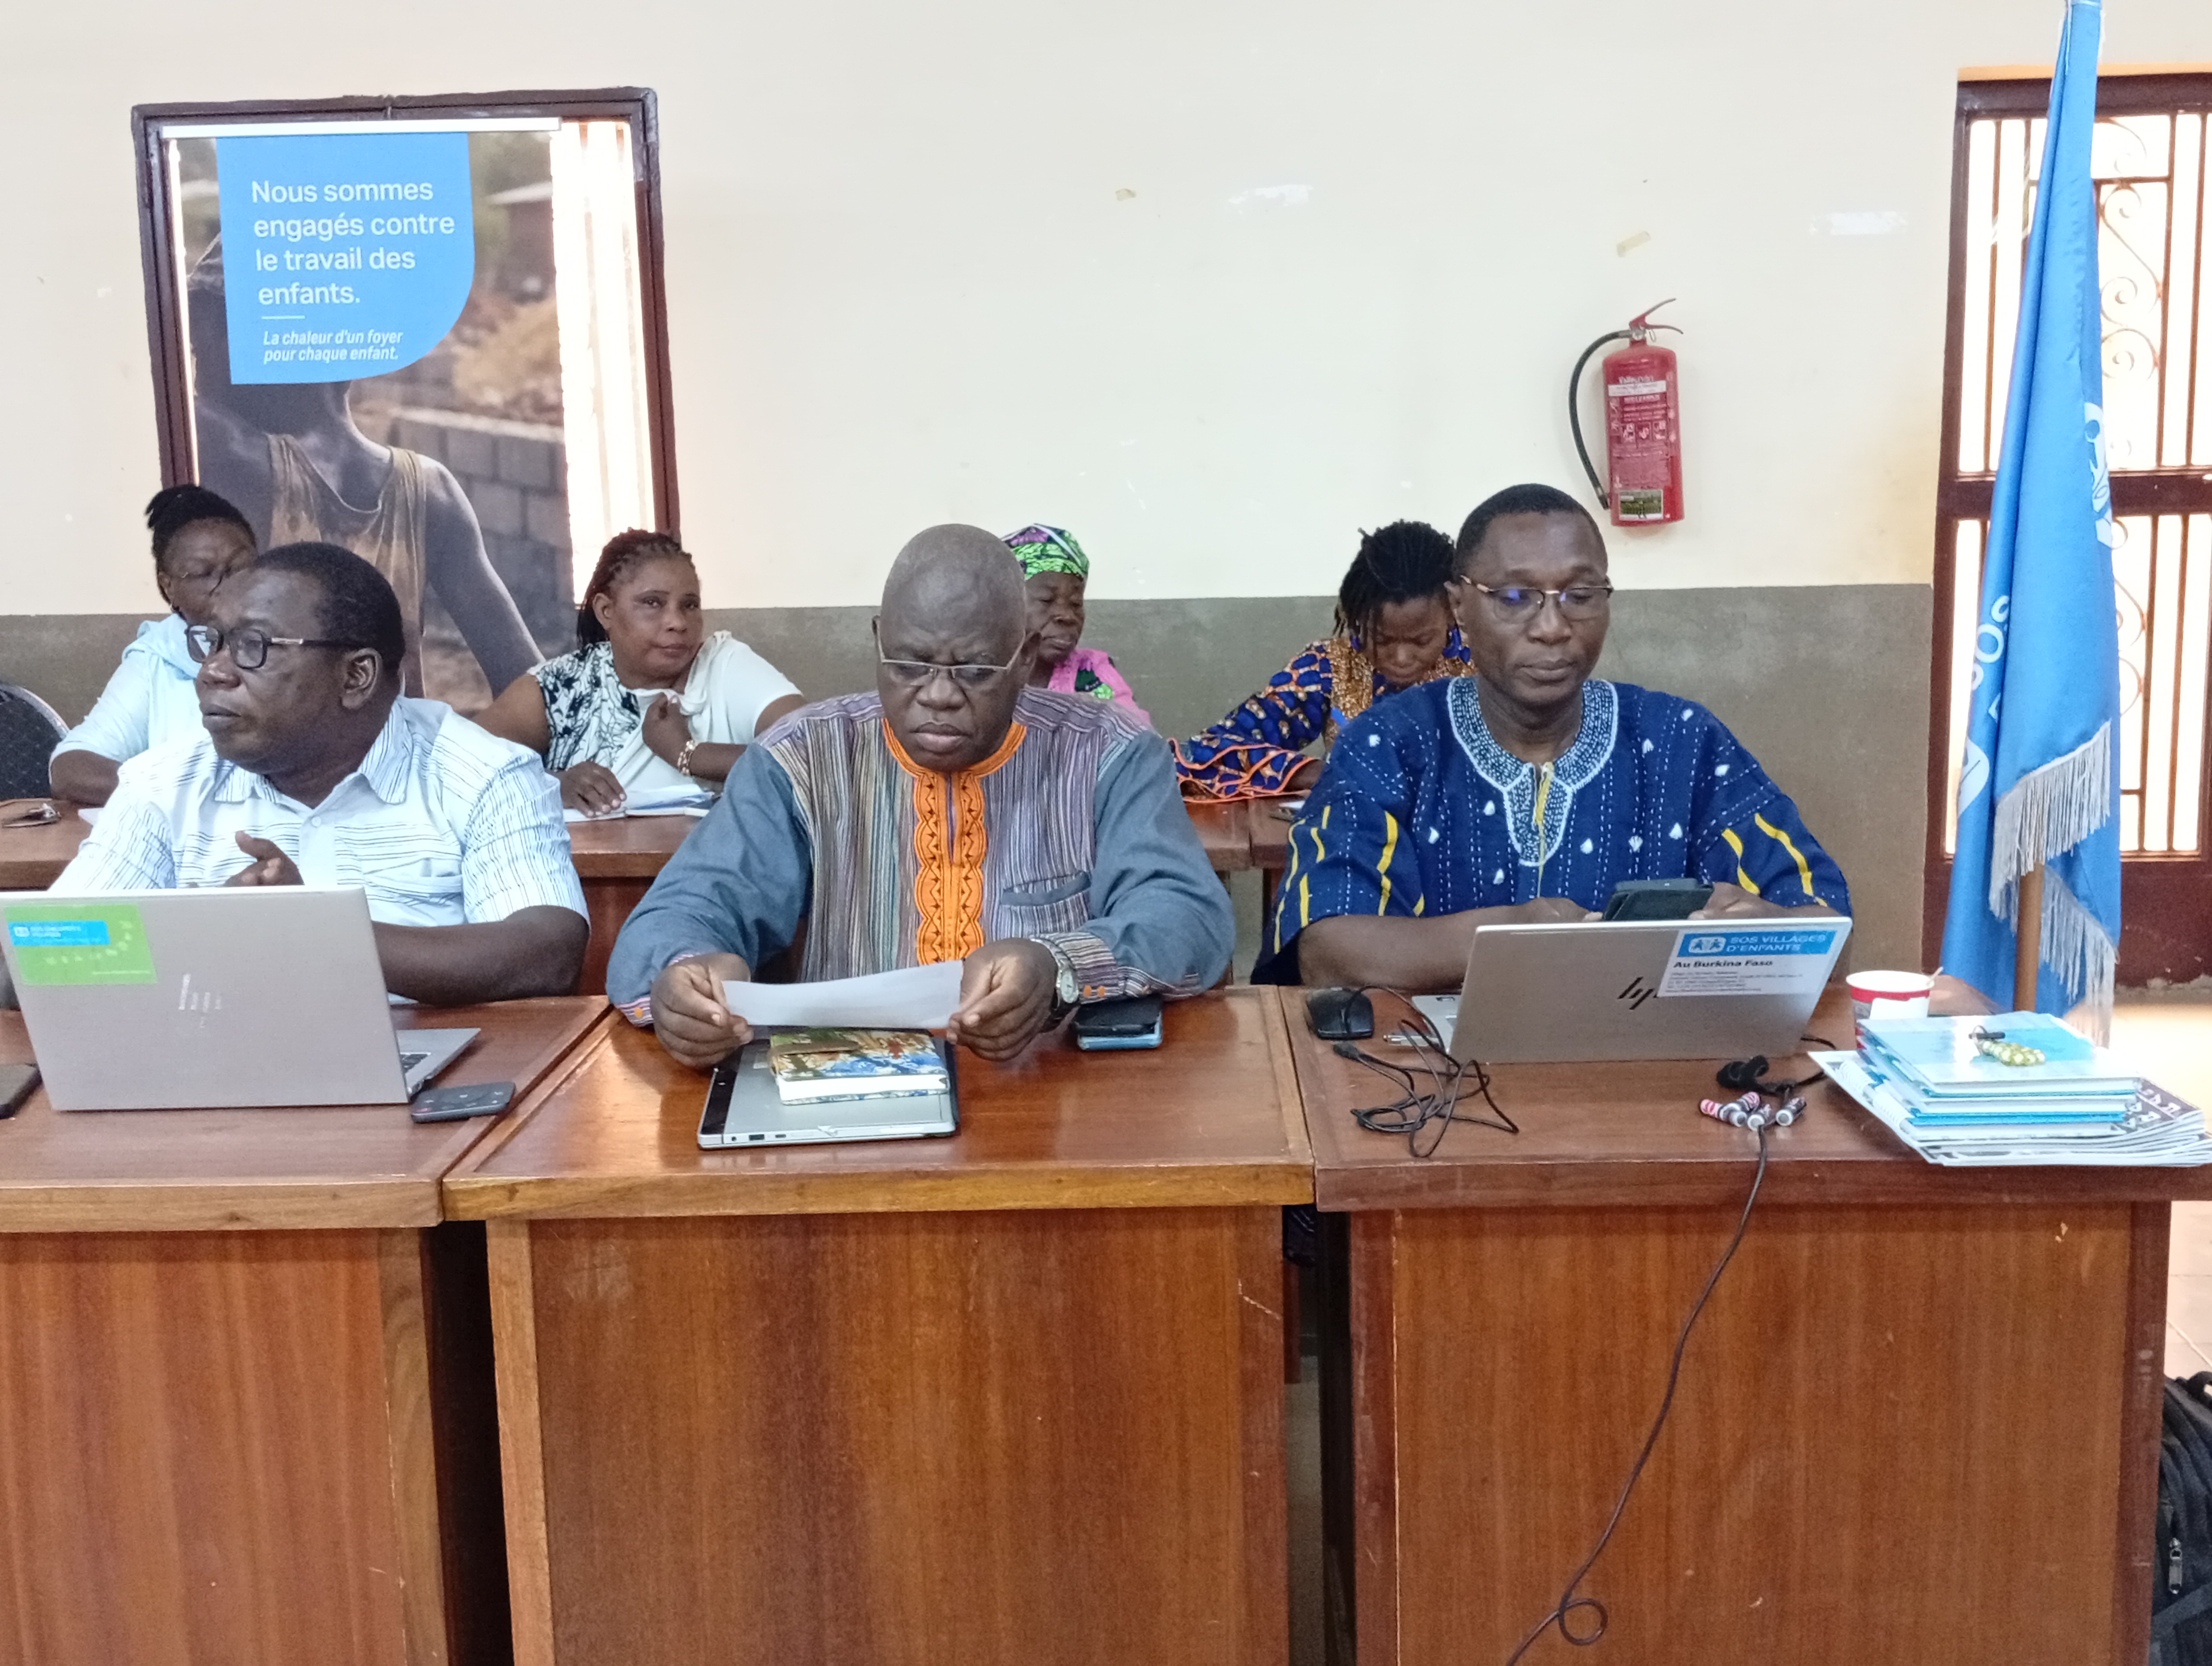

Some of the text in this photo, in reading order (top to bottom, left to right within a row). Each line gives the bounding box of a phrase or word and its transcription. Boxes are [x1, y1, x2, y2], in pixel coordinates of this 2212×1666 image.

[252, 180, 434, 203] Nous sommes
[254, 212, 455, 242] engagés contre
[256, 246, 415, 271] le travail des
[258, 282, 360, 305] enfants.
[263, 329, 403, 347] La chaleur d'un foyer
[263, 345, 399, 364] pour chaque enfant.
